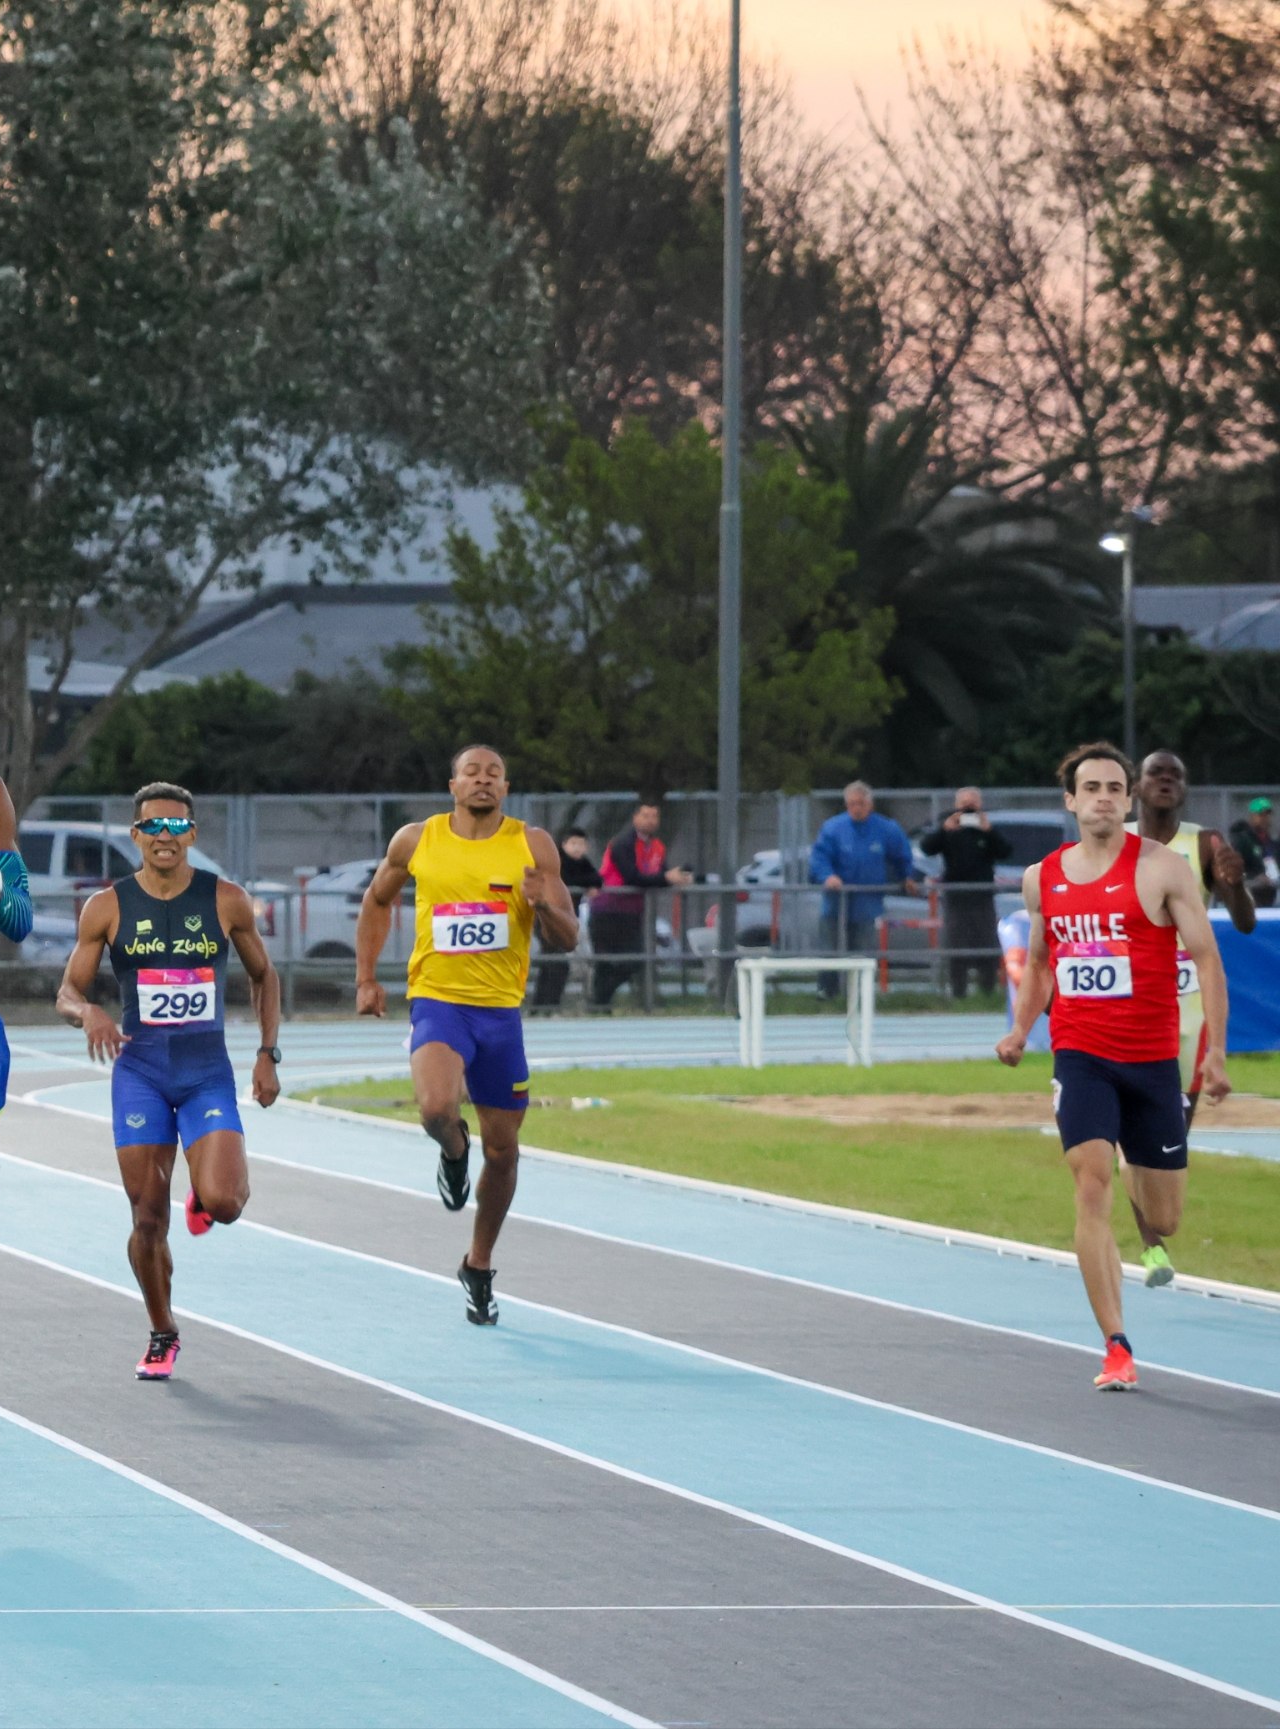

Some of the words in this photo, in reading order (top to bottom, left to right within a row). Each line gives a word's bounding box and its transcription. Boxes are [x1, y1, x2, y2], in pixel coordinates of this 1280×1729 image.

[447, 921, 496, 947] 168
[1051, 913, 1128, 943] CHILE
[1067, 964, 1116, 991] 130
[150, 991, 208, 1018] 299
